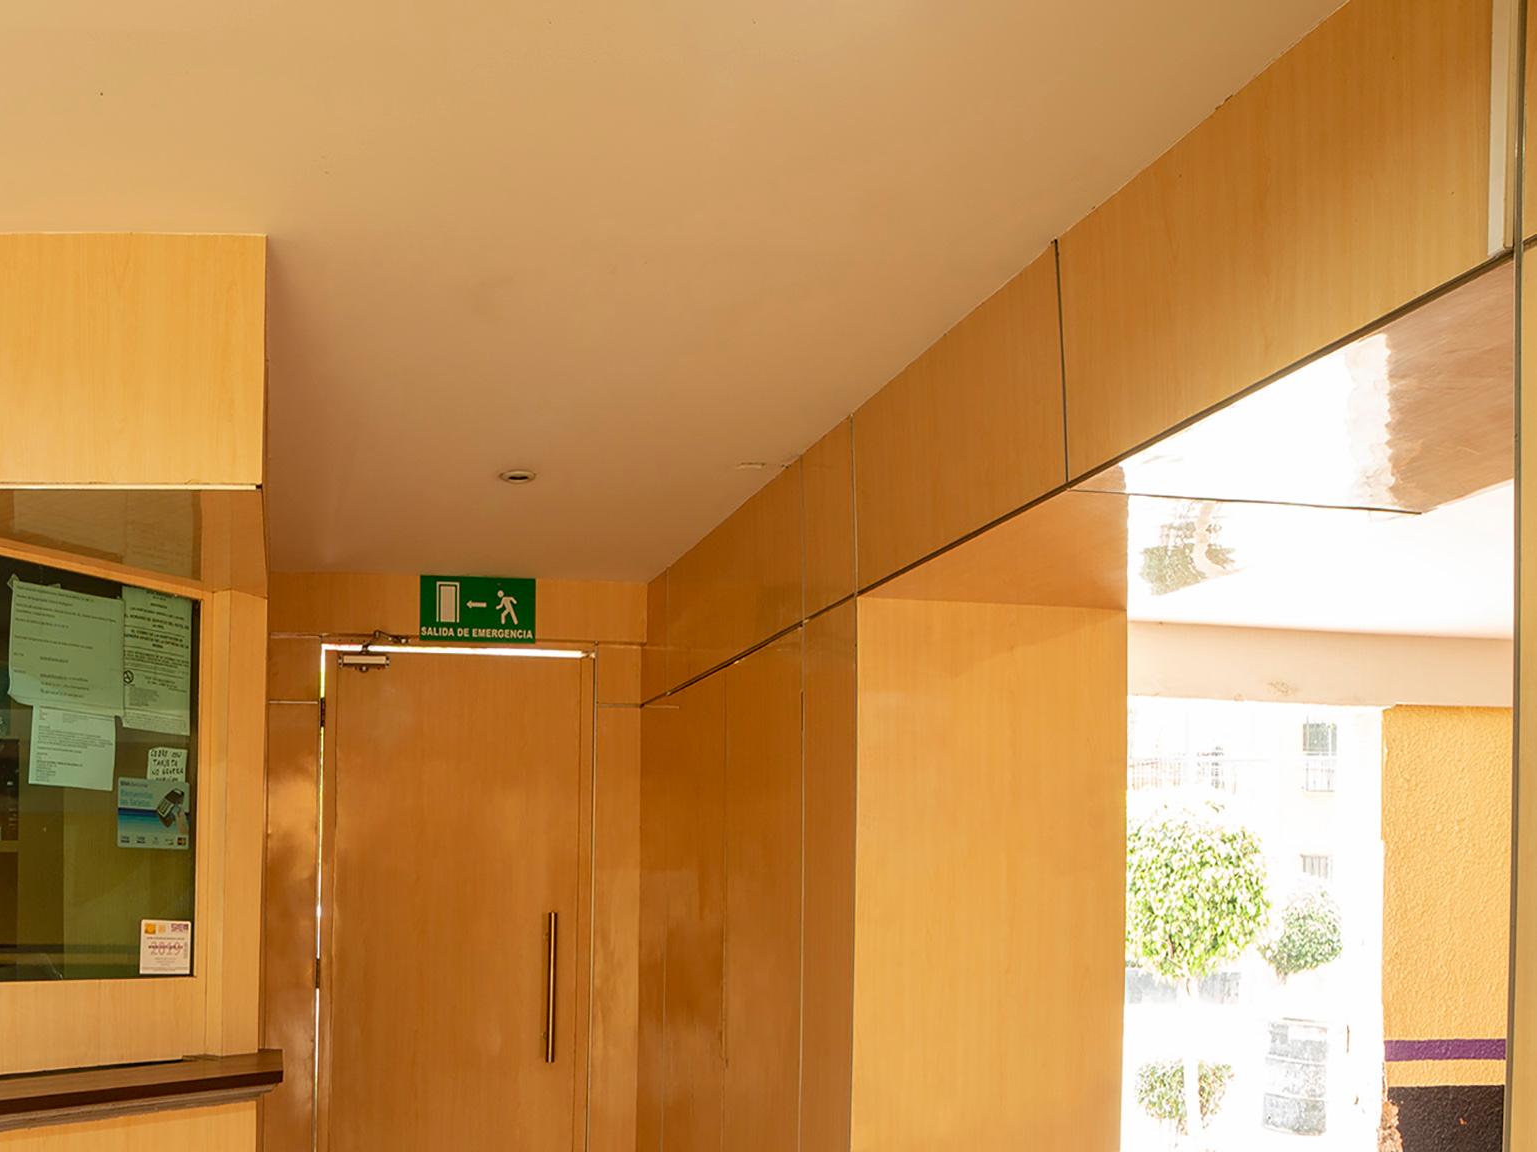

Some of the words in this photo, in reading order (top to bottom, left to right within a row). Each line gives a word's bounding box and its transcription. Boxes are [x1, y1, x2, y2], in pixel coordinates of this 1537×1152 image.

[420, 626, 455, 637] SALIDA
[457, 627, 470, 637] DE
[472, 628, 533, 639] EMERGENCIA
